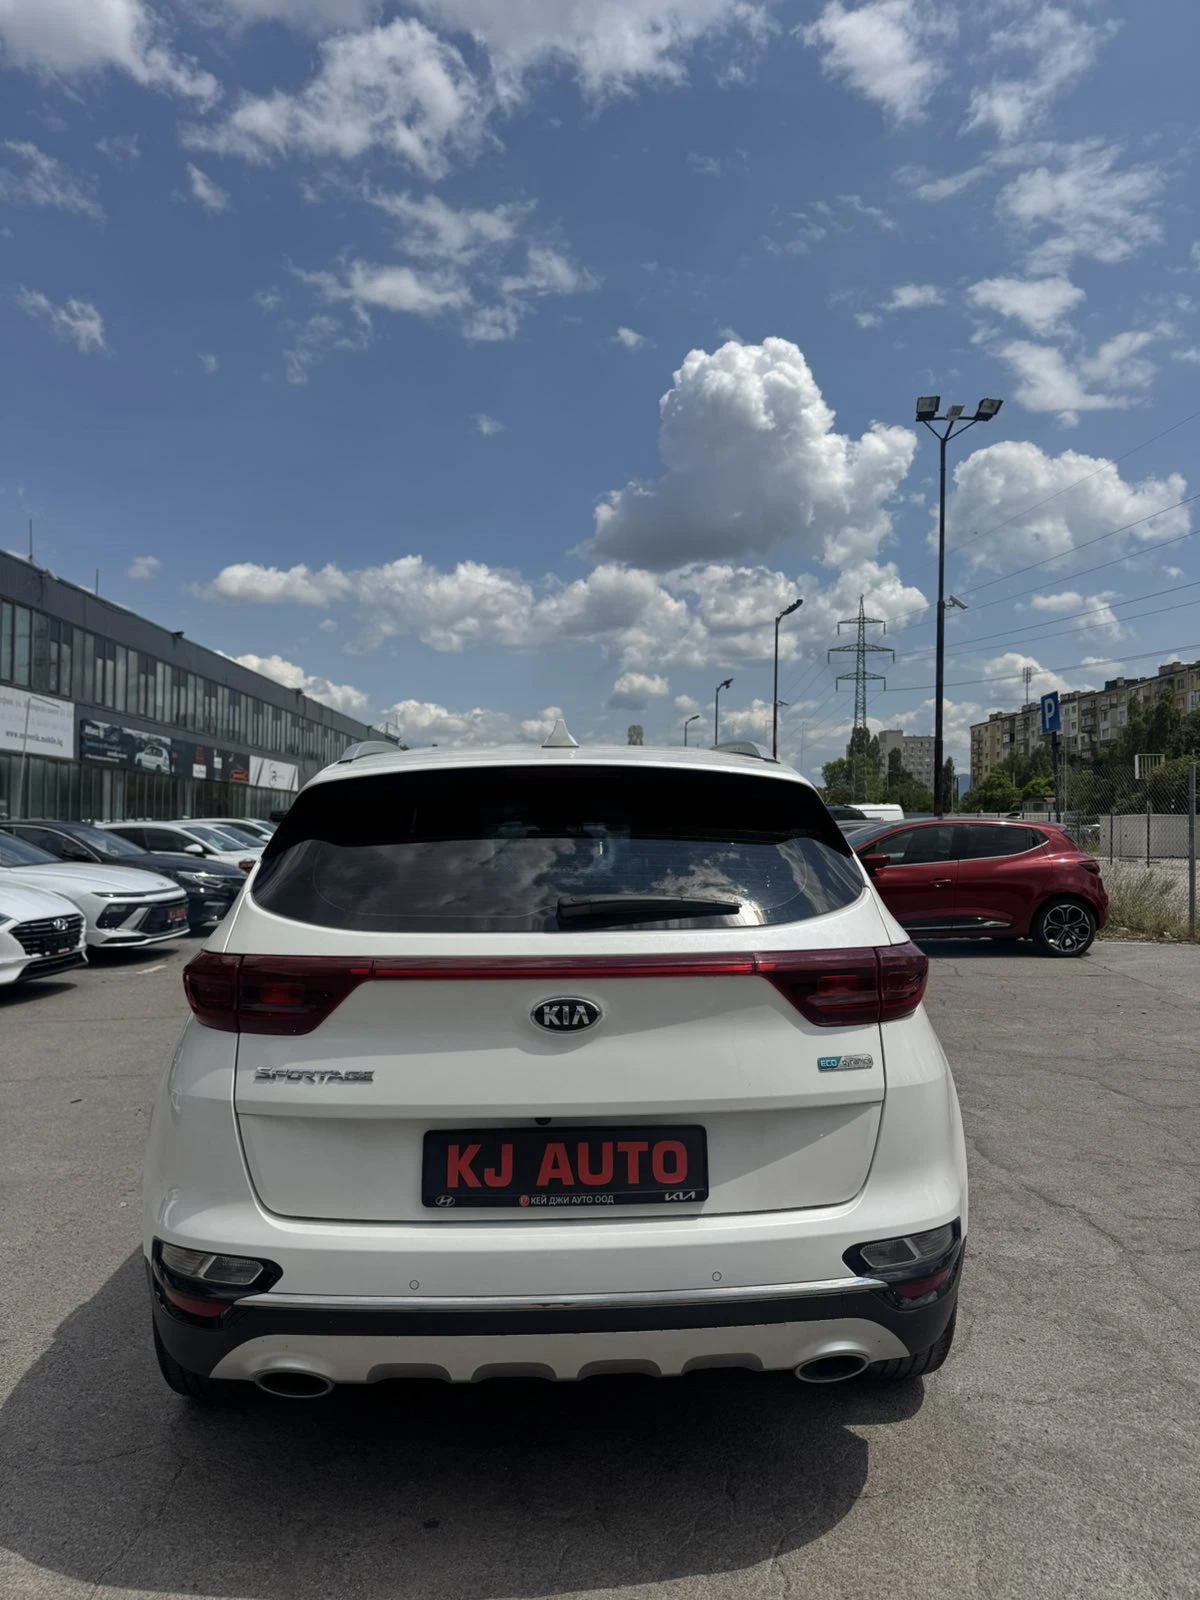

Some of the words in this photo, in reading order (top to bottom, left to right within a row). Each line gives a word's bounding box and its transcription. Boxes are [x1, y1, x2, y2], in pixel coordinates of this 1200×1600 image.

[1044, 698, 1055, 729] P
[543, 1005, 590, 1026] KIA
[820, 1059, 837, 1067] ECO
[254, 1066, 375, 1084] SPORTAGE
[446, 1143, 514, 1189] KJ
[535, 1140, 689, 1187] AUTO
[530, 1195, 547, 1205] КЕЙ
[549, 1195, 570, 1206] ДЖИ
[571, 1194, 594, 1205] АУТО
[594, 1194, 615, 1205] ООД
[664, 1191, 696, 1201] KIA
